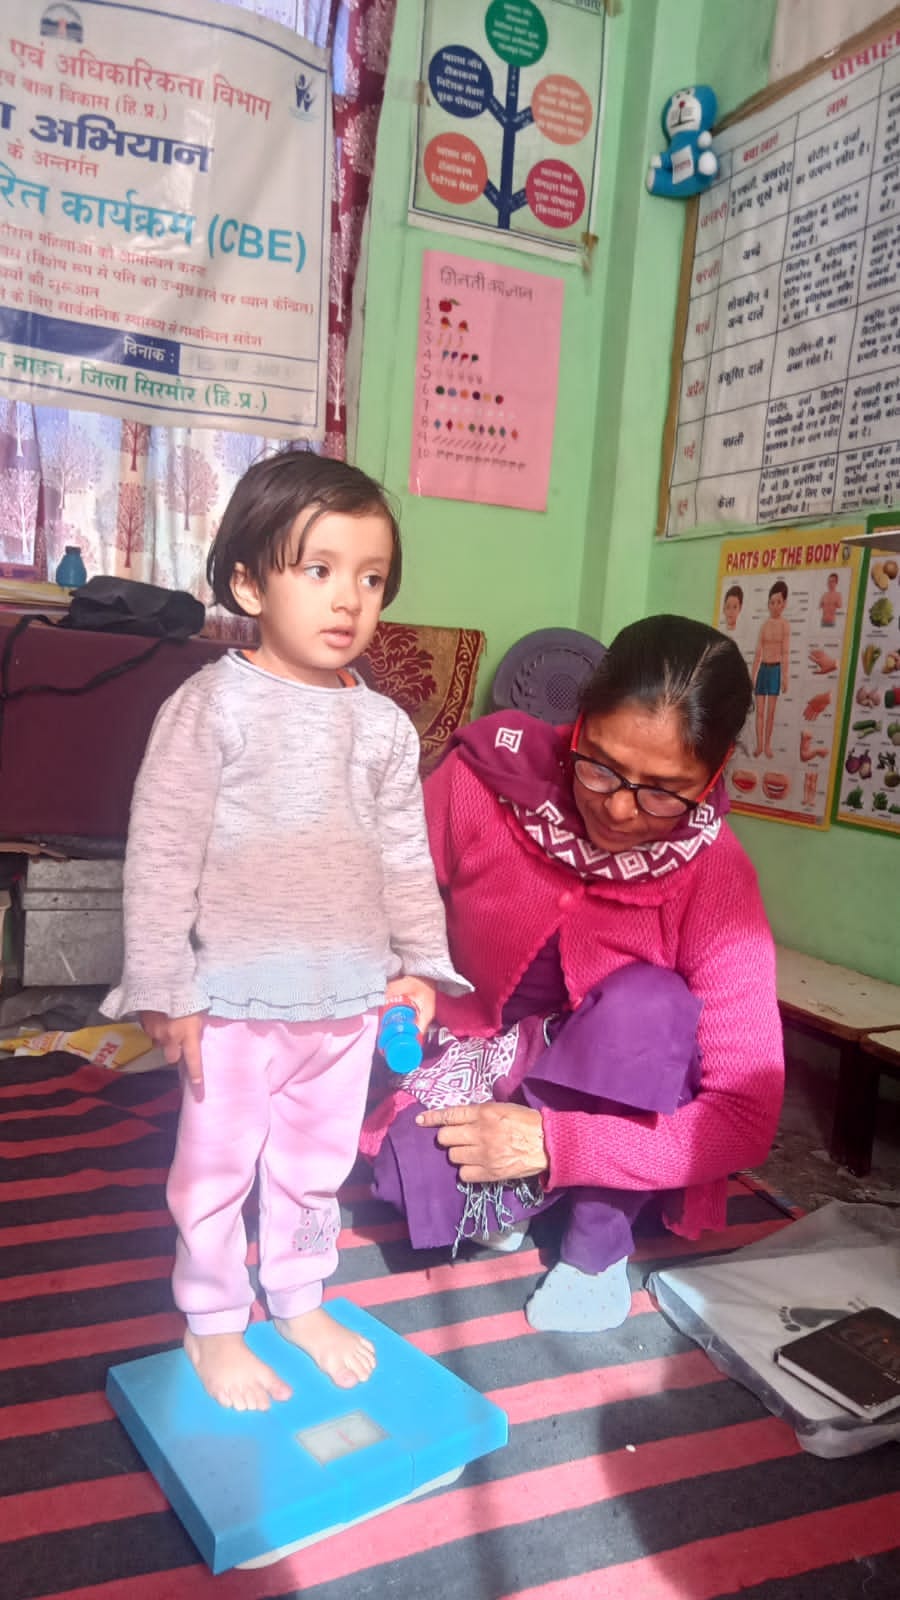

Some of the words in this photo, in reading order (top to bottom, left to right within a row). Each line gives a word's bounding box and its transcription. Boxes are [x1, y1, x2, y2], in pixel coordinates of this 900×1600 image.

[10, 38, 45, 69] एवं
[56, 48, 204, 100] अधिकारिकता
[212, 74, 271, 120] विभाग
[60, 81, 109, 111] विकास
[8, 138, 24, 161] के
[33, 149, 99, 178] अन्तर्गत
[29, 112, 214, 173] अभियान
[60, 188, 197, 246] कार्यक्रम
[207, 212, 307, 273] (CBE)
[123, 336, 166, 362] दिनांक
[79, 360, 128, 393] जिला
[135, 370, 196, 402] सिरमौर
[726, 549, 760, 571] PARTS
[761, 548, 777, 568] OF
[780, 545, 804, 567] THE
[806, 542, 841, 565] BODY
